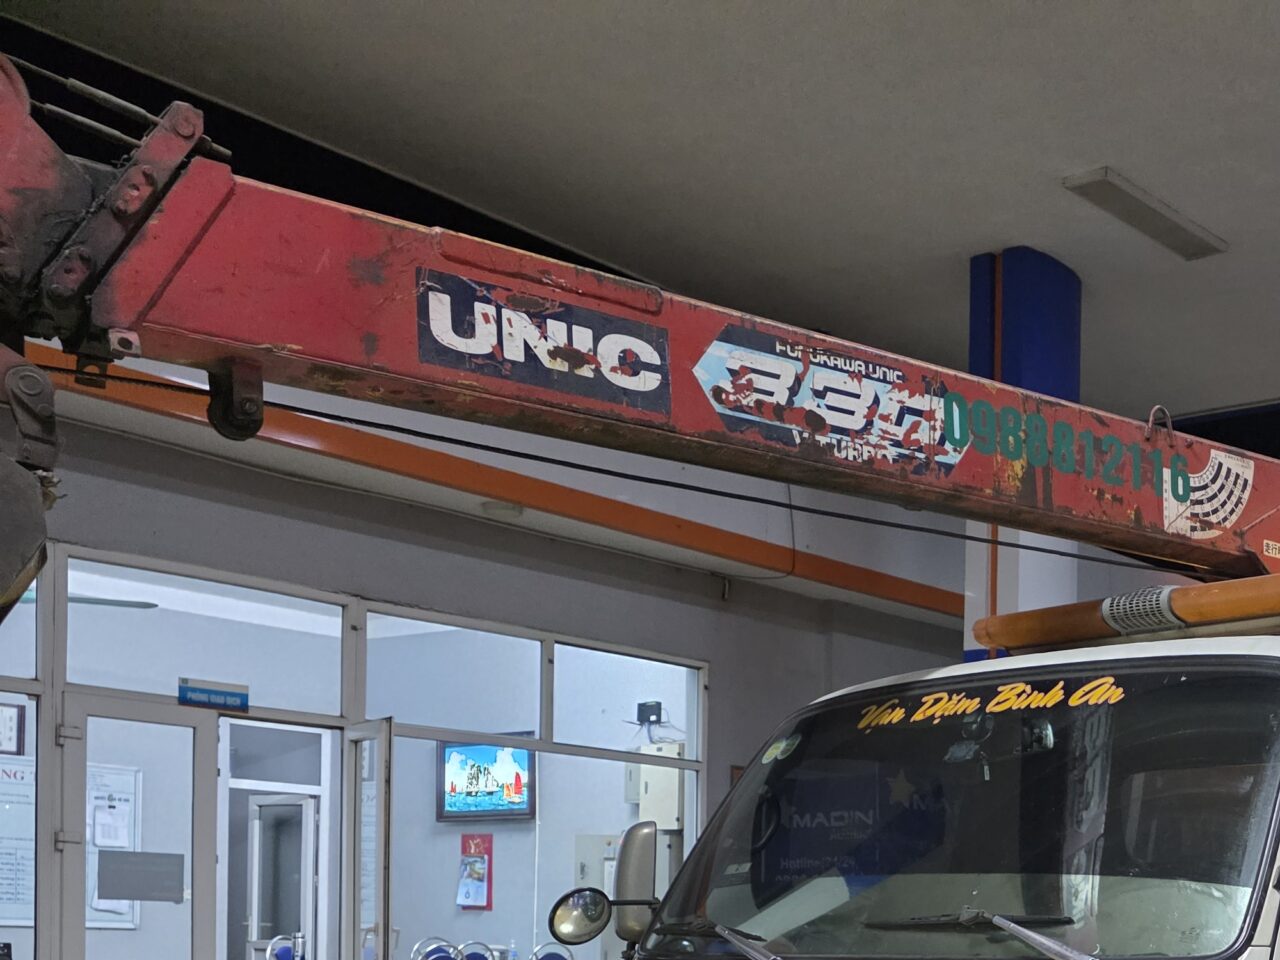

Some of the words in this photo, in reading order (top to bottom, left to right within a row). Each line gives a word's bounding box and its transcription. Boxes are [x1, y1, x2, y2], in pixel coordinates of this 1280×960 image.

[429, 291, 661, 391] UNIC
[868, 366, 904, 383] UNIC
[943, 392, 1191, 503] 0988812116
[857, 699, 905, 734] Vạn
[986, 680, 1065, 713] Bình
[1068, 676, 1125, 707] An
